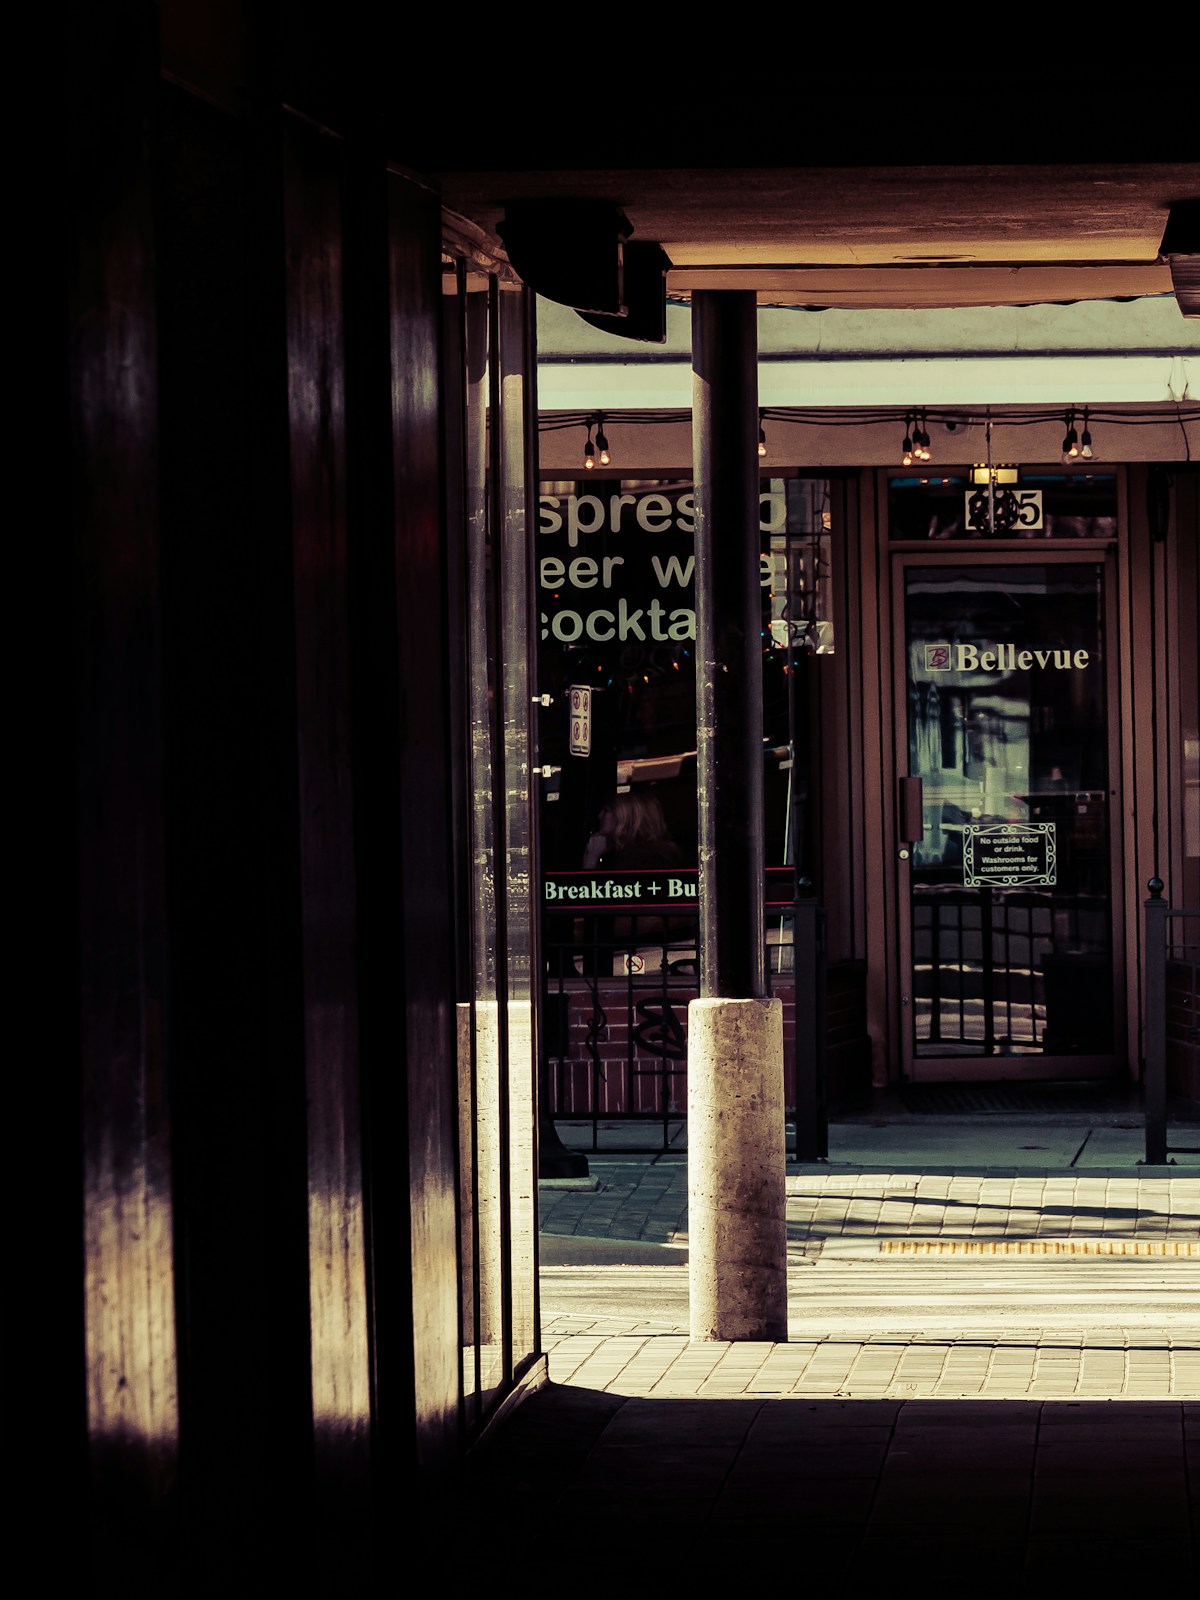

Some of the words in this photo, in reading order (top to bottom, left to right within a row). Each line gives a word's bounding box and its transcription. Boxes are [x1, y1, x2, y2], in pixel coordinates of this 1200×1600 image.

[540, 493, 787, 548] spreso
[540, 556, 625, 589] eer
[651, 555, 775, 588] we
[541, 598, 696, 642] ockta
[955, 643, 1090, 671] Bellevue
[993, 837, 1020, 845] outside
[1021, 836, 1039, 844] food
[1004, 845, 1025, 853] drink.
[981, 856, 1025, 864] Washrooms
[1026, 855, 1039, 863] for
[981, 865, 1020, 873] customers
[1021, 864, 1039, 873] only.
[545, 880, 642, 900] Breakfast
[667, 879, 699, 898] Bu
